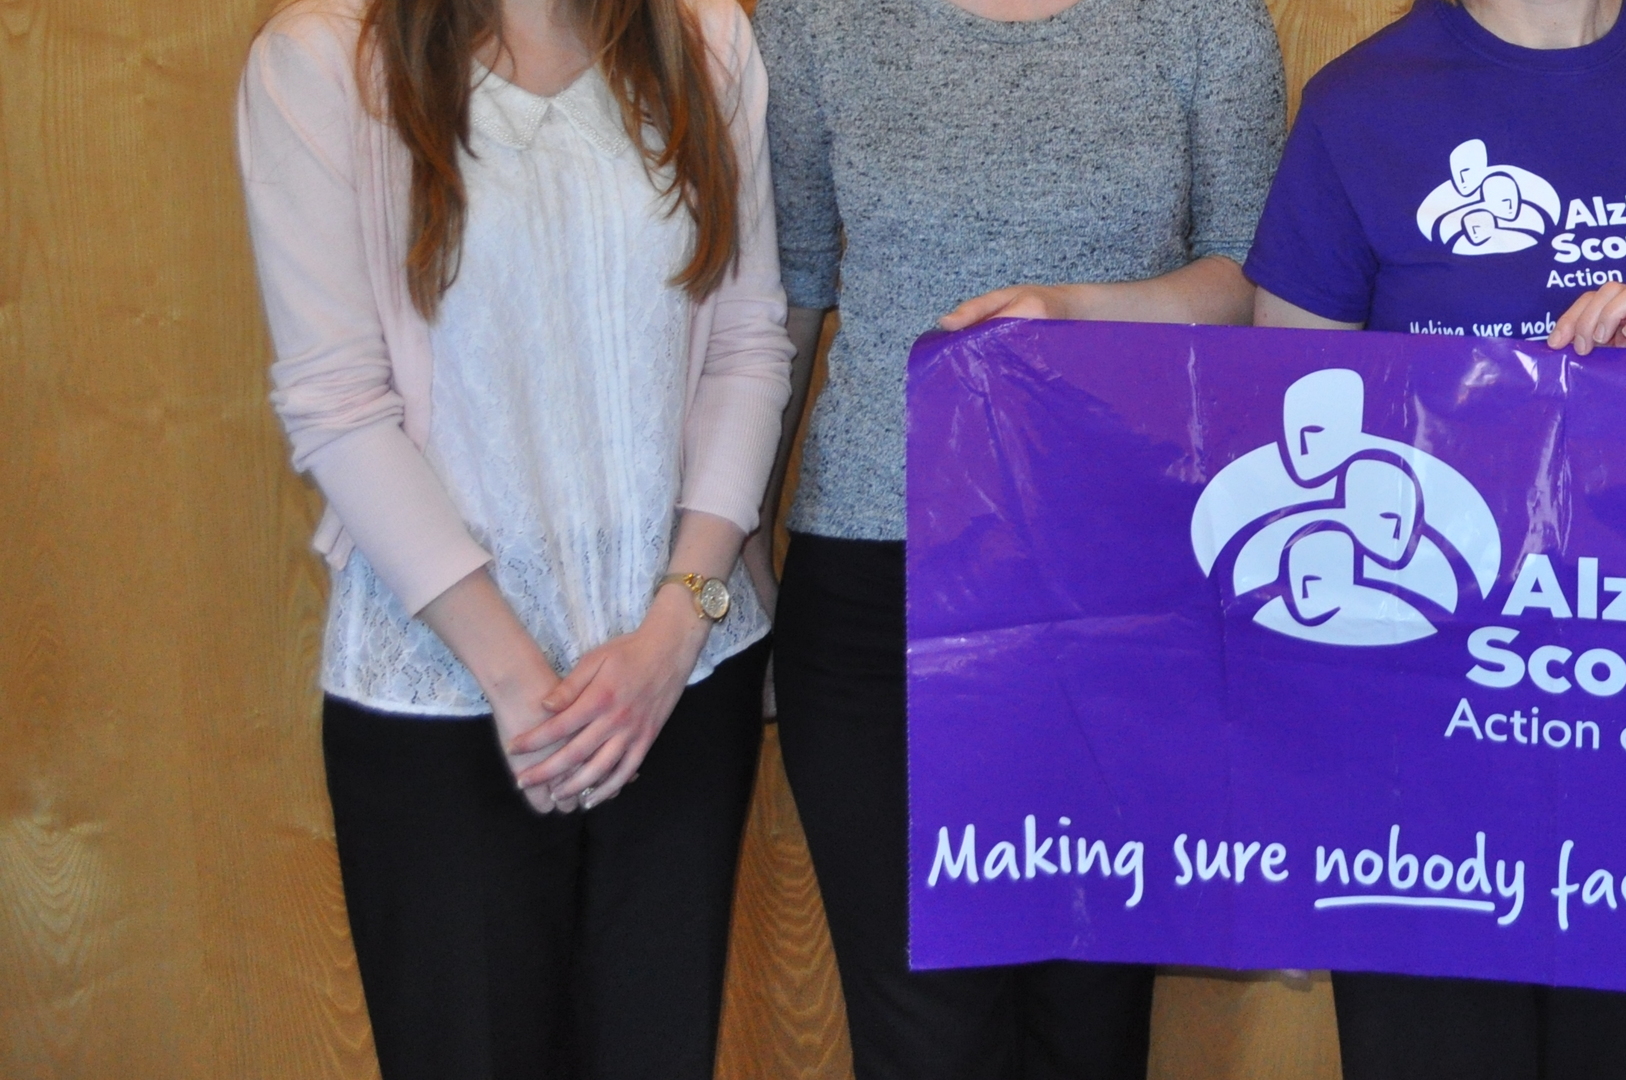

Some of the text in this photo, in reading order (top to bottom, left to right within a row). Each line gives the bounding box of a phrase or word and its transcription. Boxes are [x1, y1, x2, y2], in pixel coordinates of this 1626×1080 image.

[1546, 268, 1623, 288] Action
[1444, 699, 1600, 749] Action
[927, 814, 1145, 908] Making
[1173, 833, 1290, 886] sure
[1315, 824, 1525, 926] nobody
